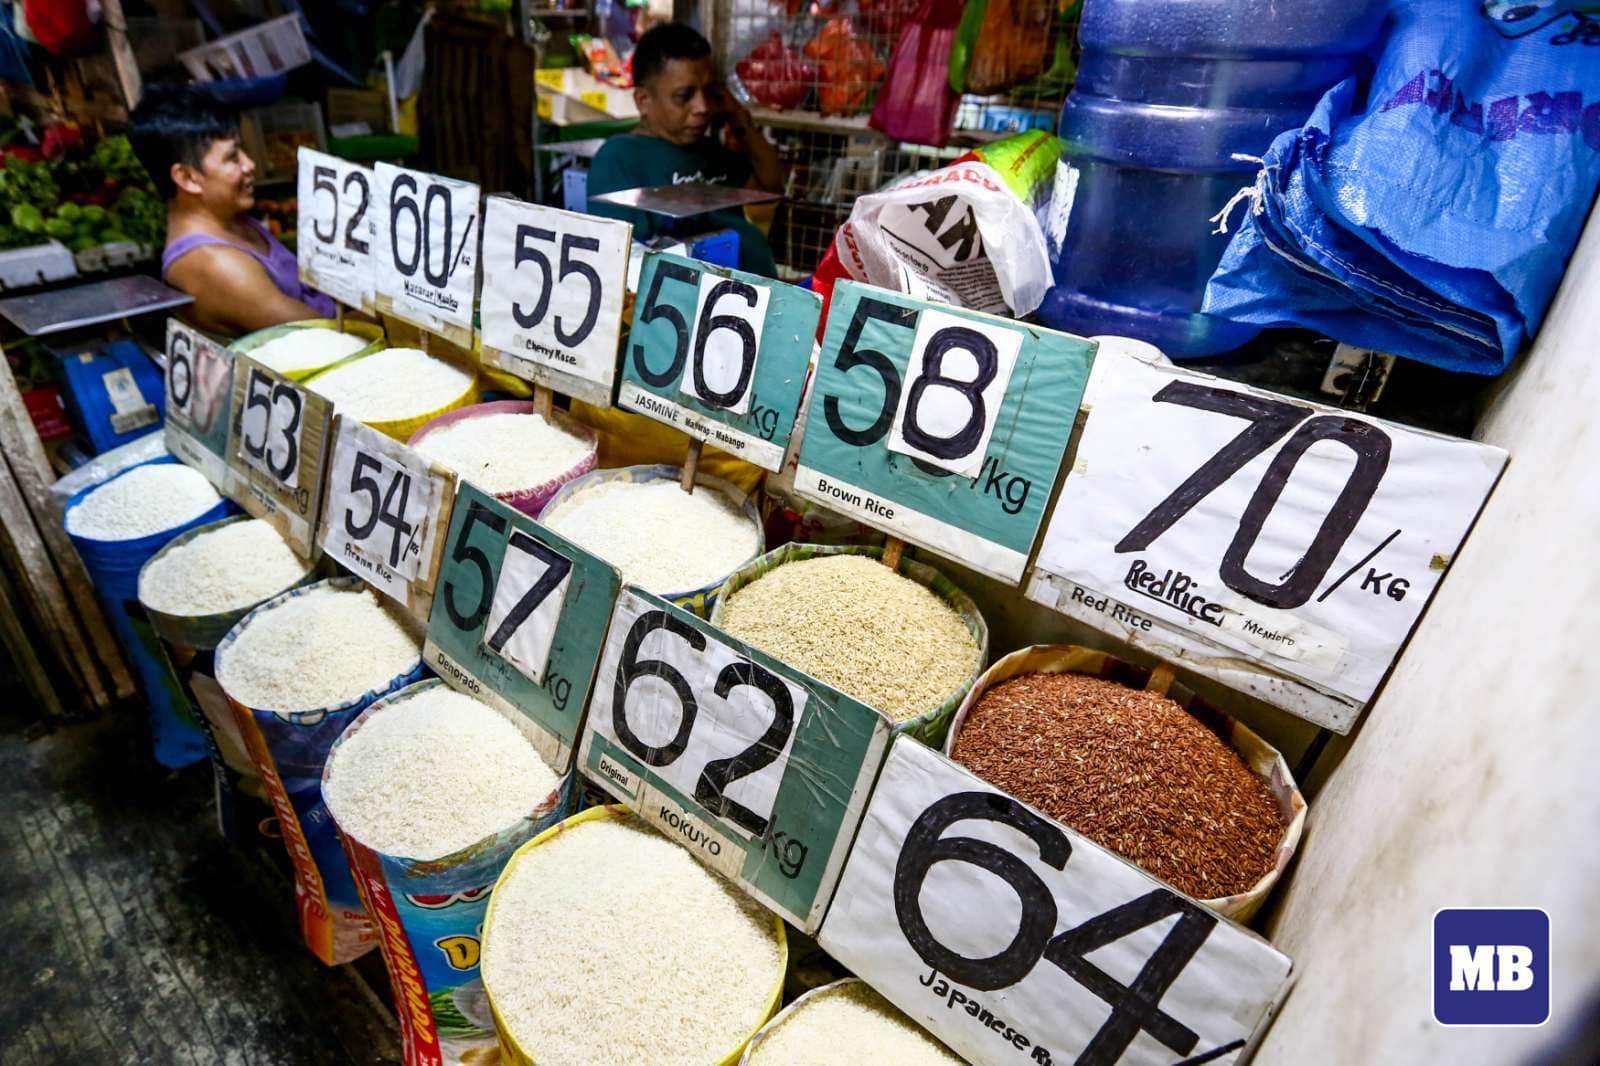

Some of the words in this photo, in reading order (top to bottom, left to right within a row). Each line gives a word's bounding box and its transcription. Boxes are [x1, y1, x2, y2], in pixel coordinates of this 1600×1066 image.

[313, 166, 370, 255] 52
[512, 224, 602, 348] 55
[633, 259, 758, 409] 56
[824, 296, 999, 461] 58
[243, 368, 302, 482] 53
[817, 478, 862, 508] Brown
[864, 497, 895, 521] Rice
[444, 499, 573, 653] 57
[1072, 586, 1107, 613] Red
[1110, 603, 1153, 632] Rice
[437, 652, 481, 695] Denorado
[612, 609, 795, 838] 62
[600, 759, 629, 786] Original
[659, 806, 722, 857] KOKUYO
[918, 969, 1031, 1058] Japanese
